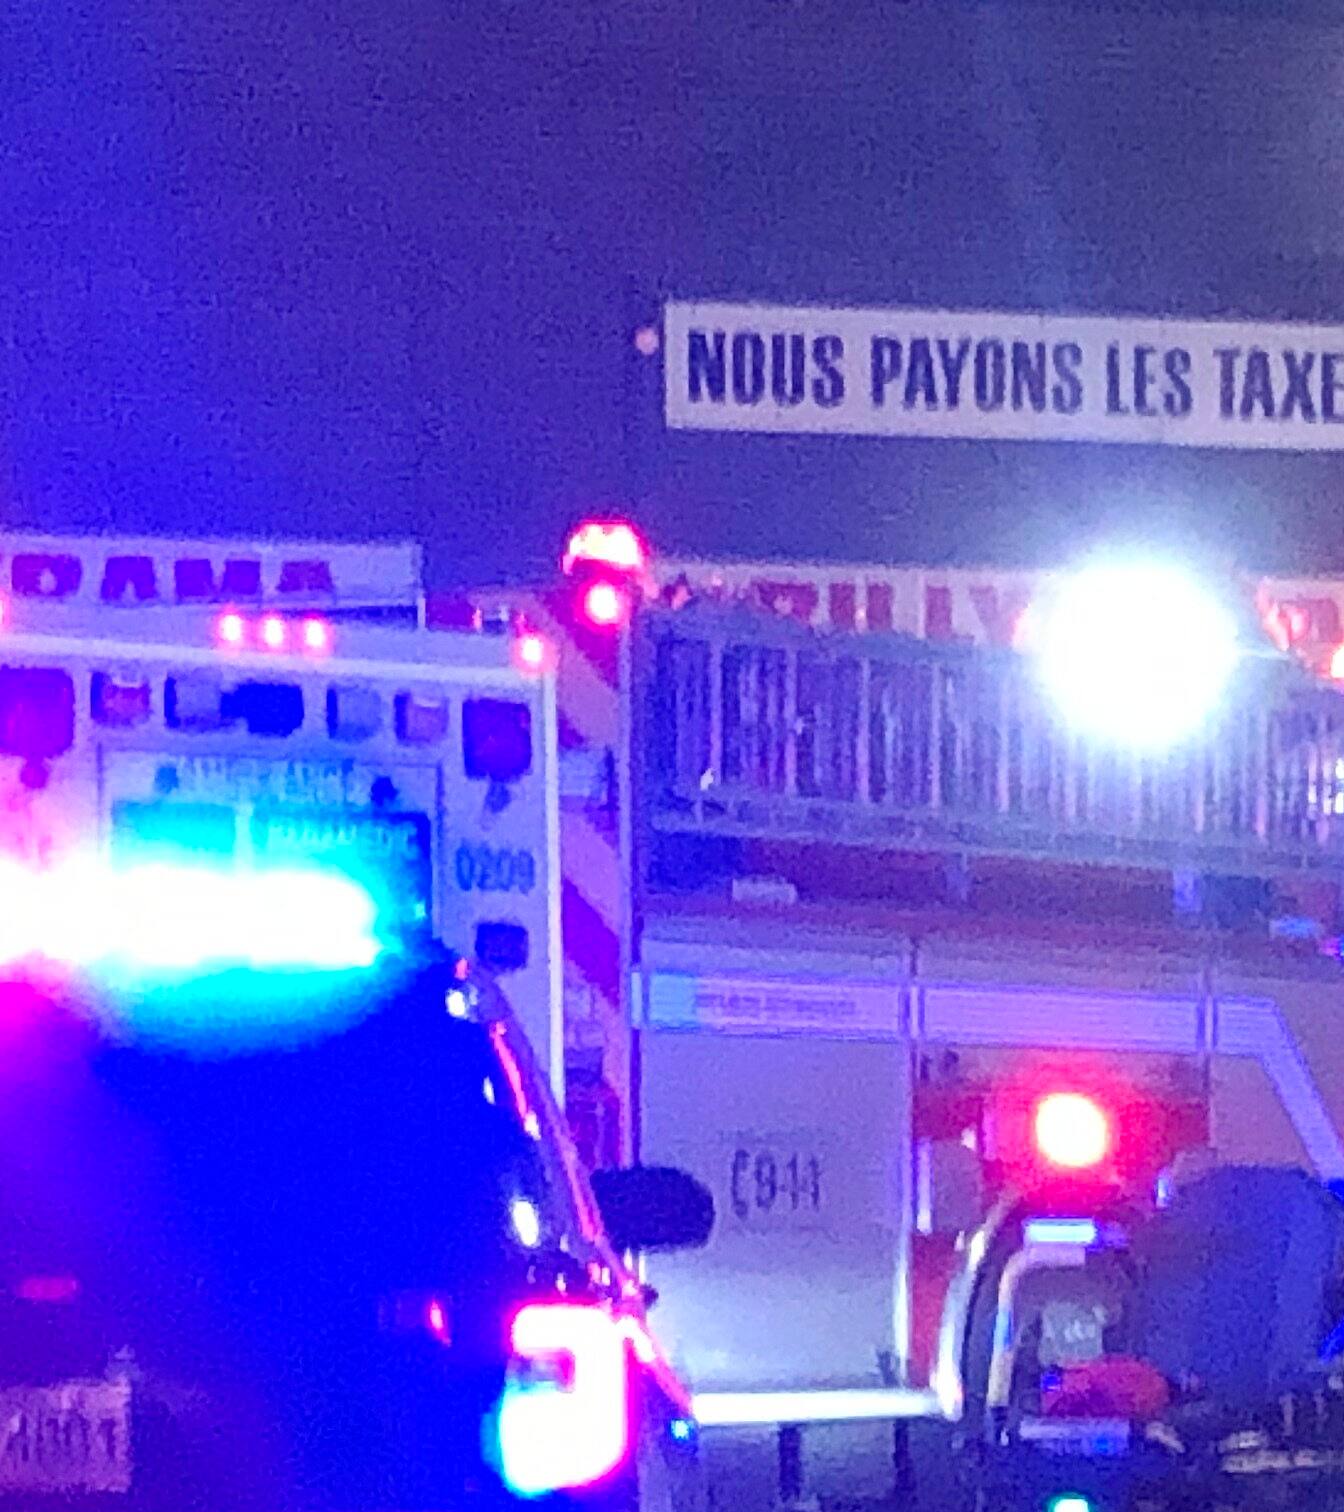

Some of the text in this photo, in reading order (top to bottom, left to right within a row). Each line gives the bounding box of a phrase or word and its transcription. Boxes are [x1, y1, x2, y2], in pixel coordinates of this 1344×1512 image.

[686, 329, 846, 408] NOUS
[868, 335, 1084, 417] PAYONS
[1104, 341, 1195, 419] LES
